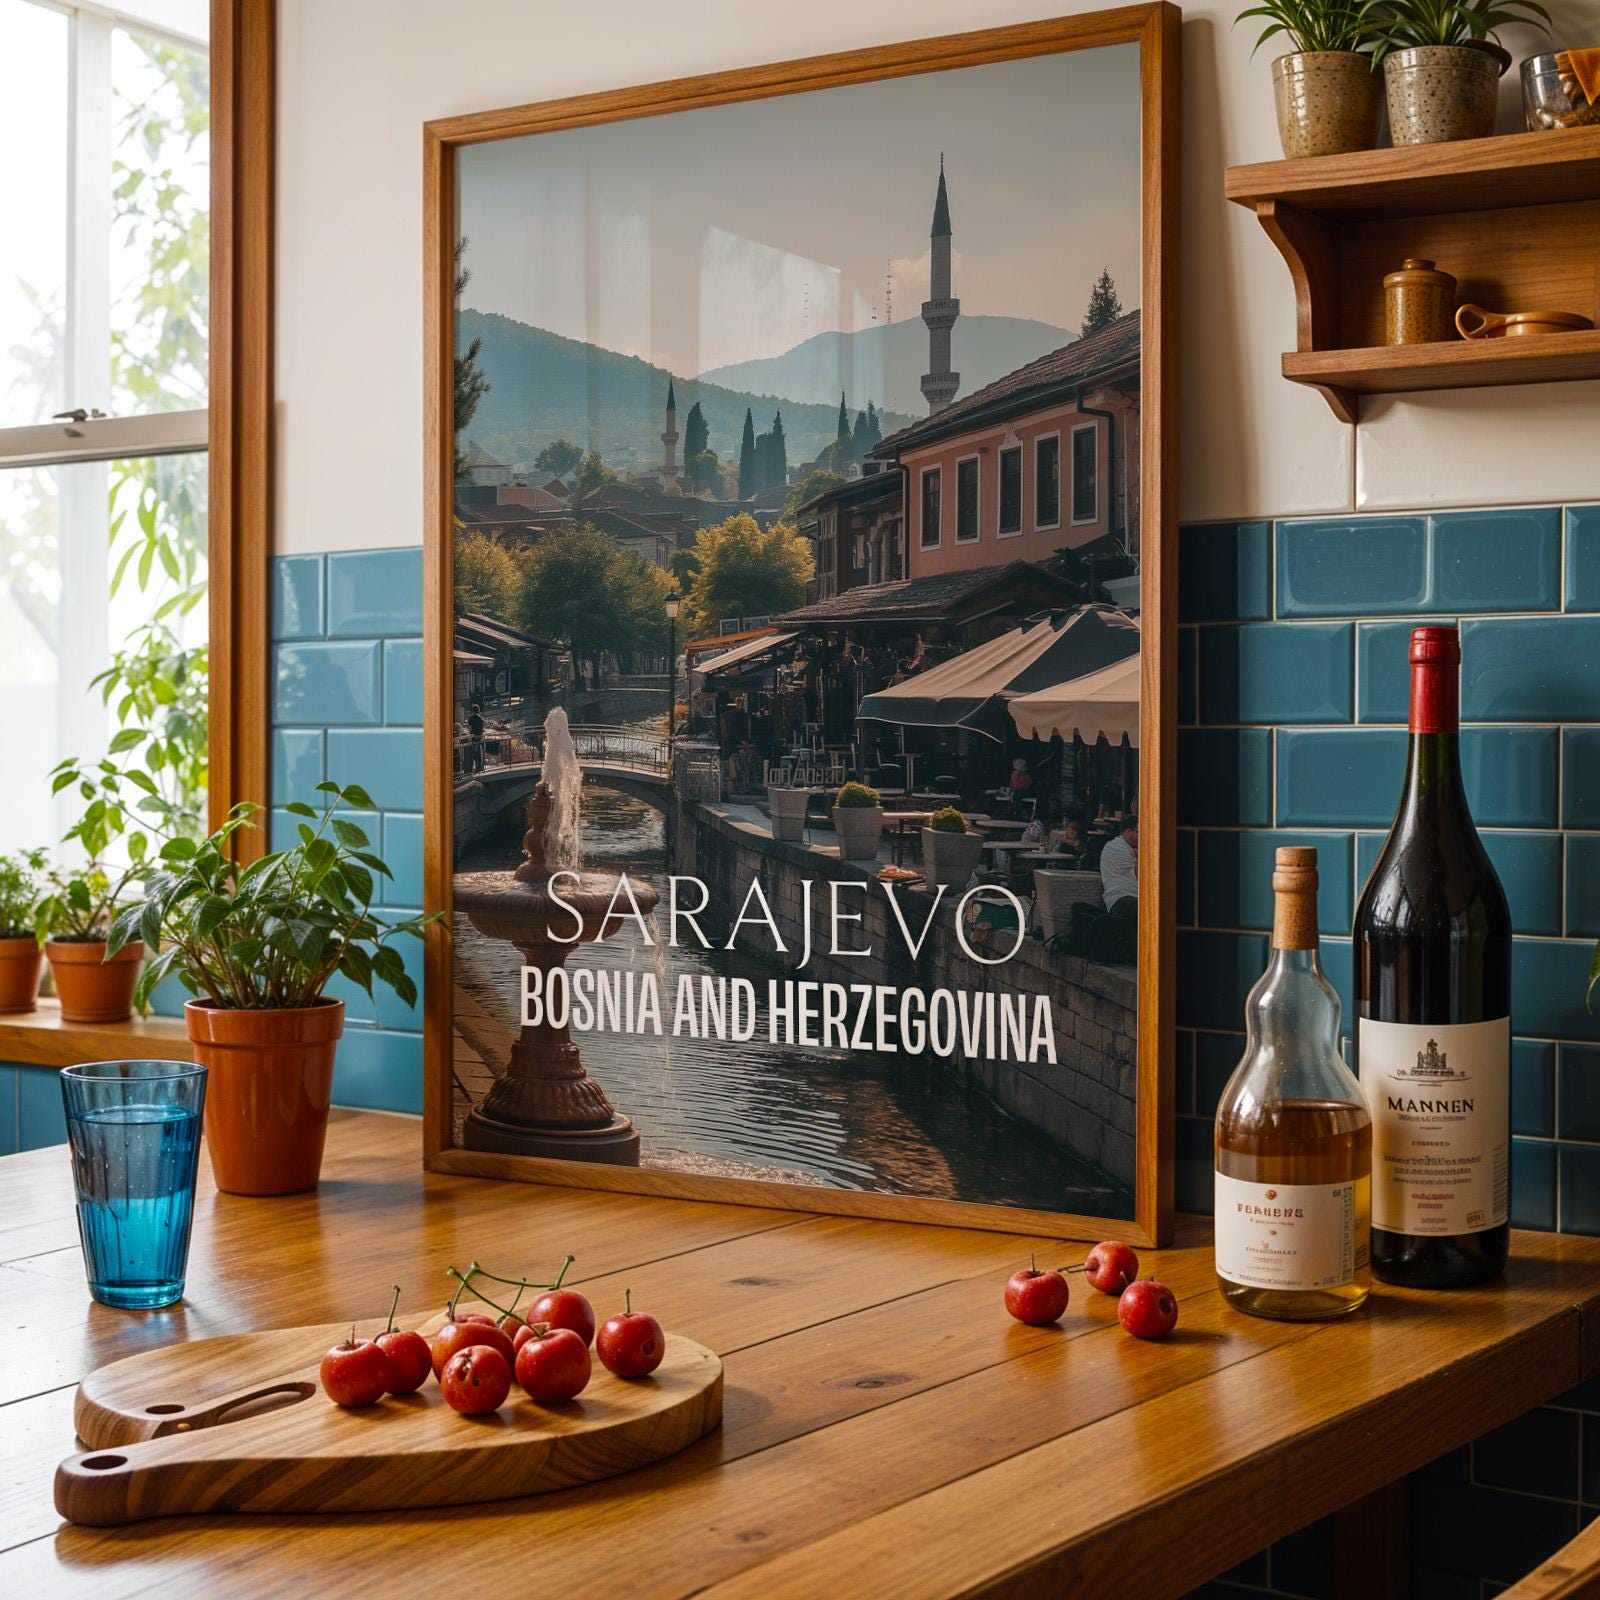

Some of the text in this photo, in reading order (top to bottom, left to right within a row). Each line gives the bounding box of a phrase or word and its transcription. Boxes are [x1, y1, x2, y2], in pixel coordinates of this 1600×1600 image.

[546, 870, 1027, 968] SARAJEVO
[520, 966, 1057, 1064] BOSNIA AND HERZEGOVINA
[1388, 1096, 1474, 1113] MANNEN
